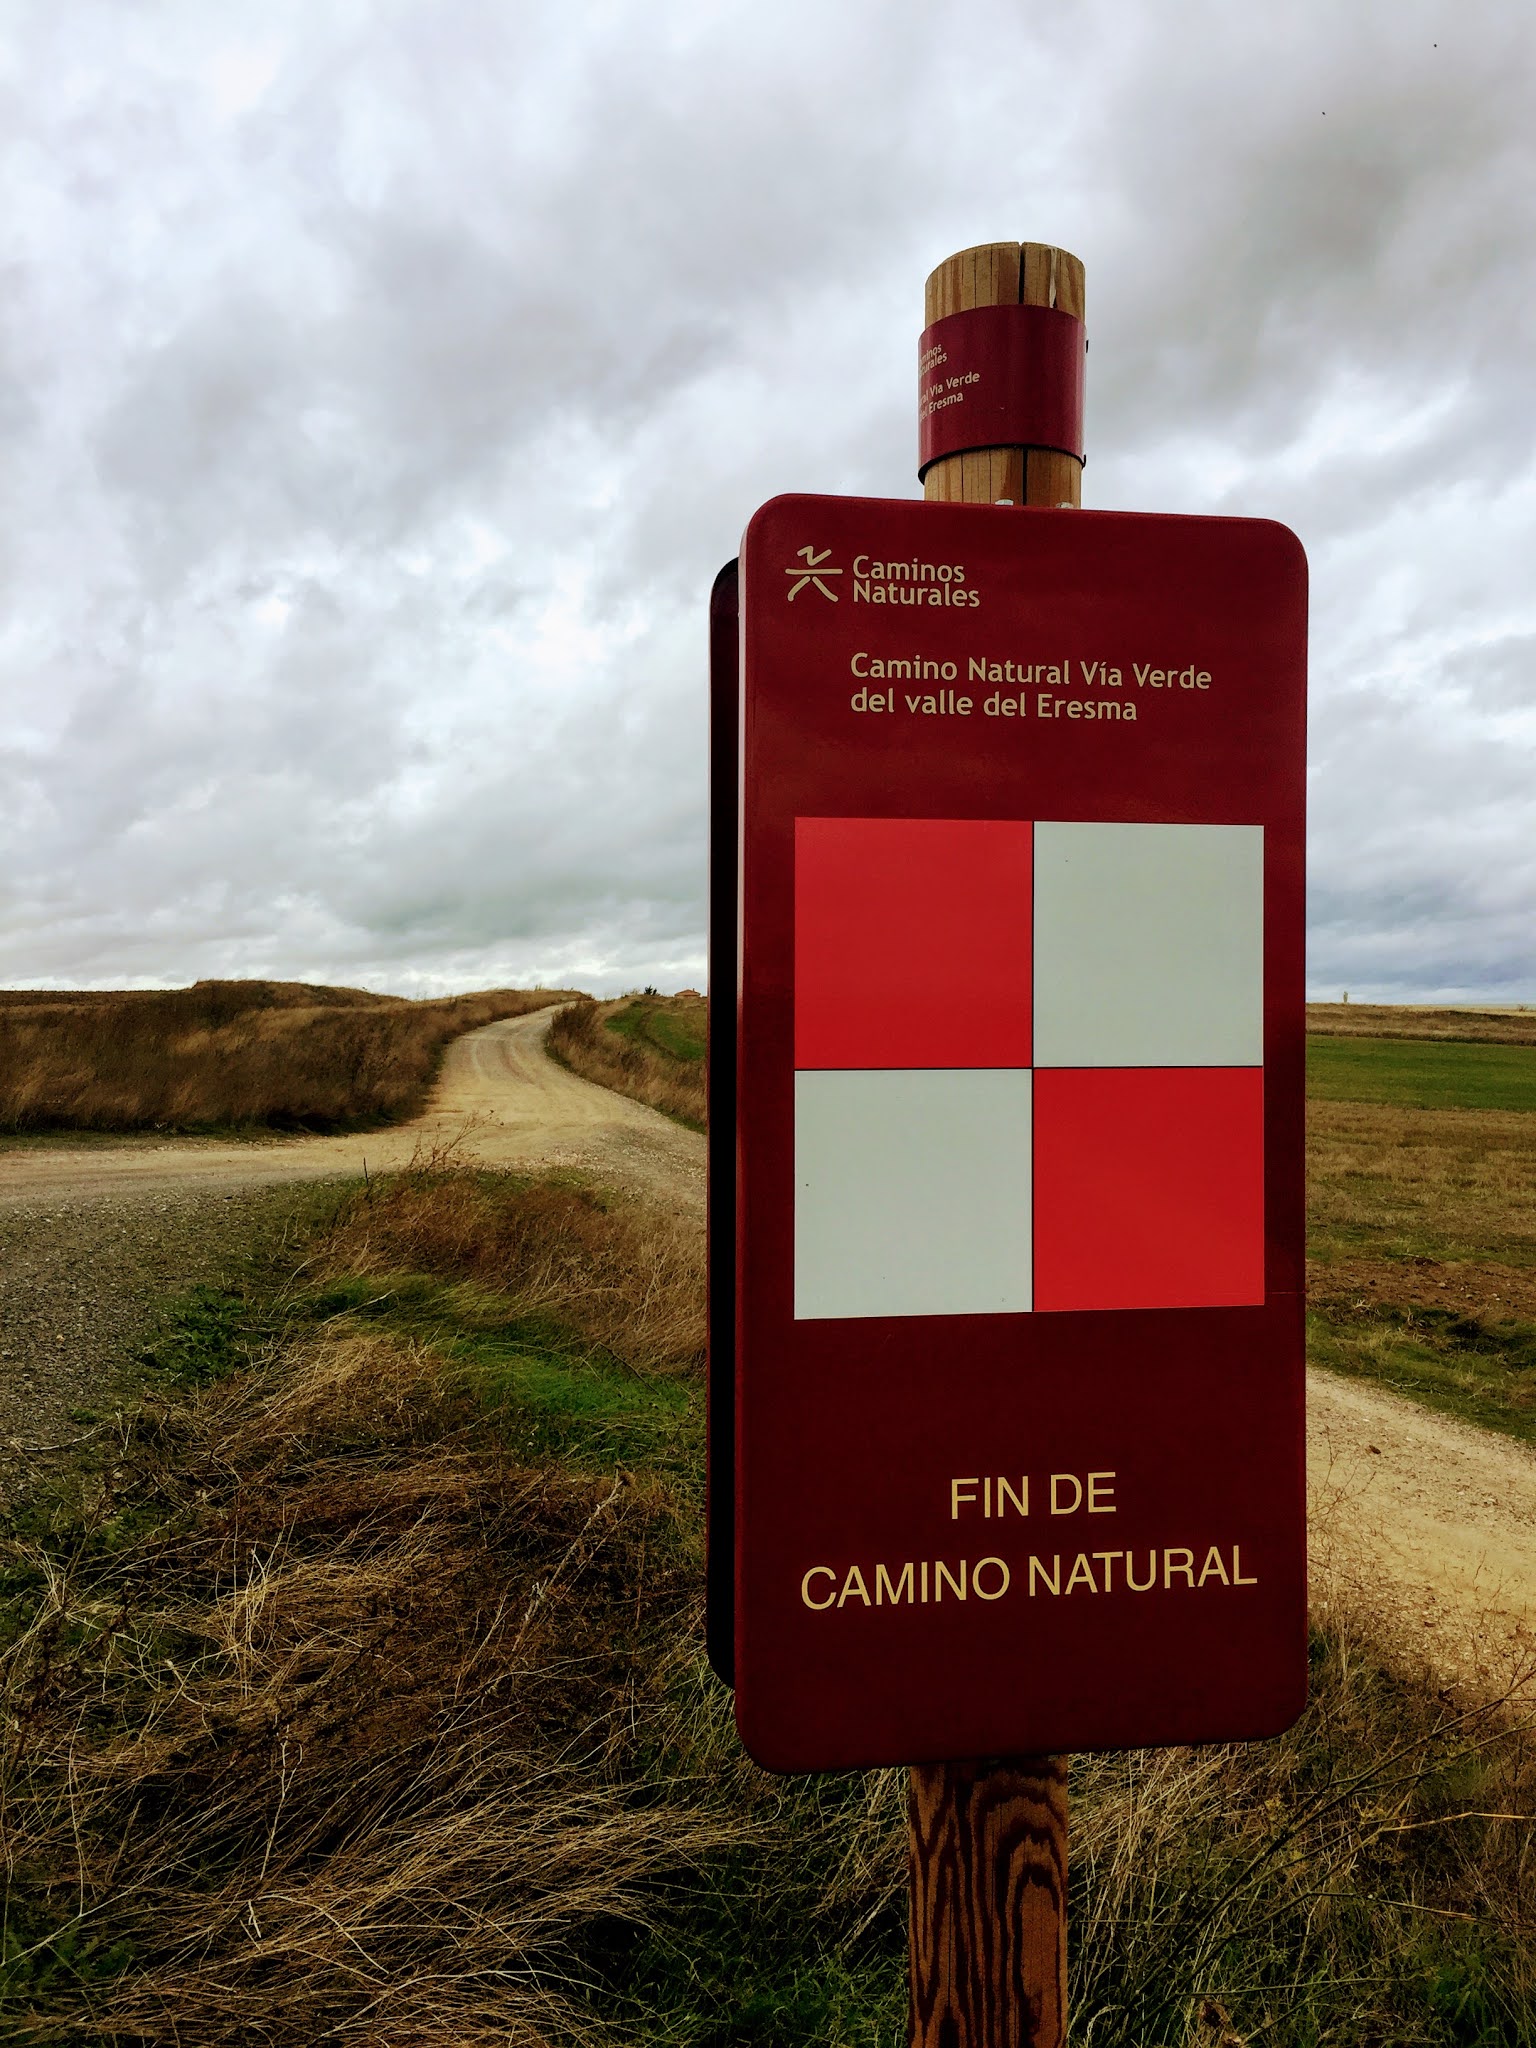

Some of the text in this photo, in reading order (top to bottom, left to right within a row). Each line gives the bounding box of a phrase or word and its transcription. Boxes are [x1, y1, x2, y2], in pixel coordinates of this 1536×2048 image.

[946, 371, 981, 390] Verde
[929, 392, 964, 414] Eresma
[853, 556, 965, 583] Caminos
[853, 580, 980, 608] Naturales
[850, 652, 1212, 690] Camino Natural Vía Verde
[850, 686, 1137, 721] del valle del Eresma
[951, 1471, 1117, 1520] FIN DE
[801, 1544, 1258, 1610] CAMINO NATURAL
